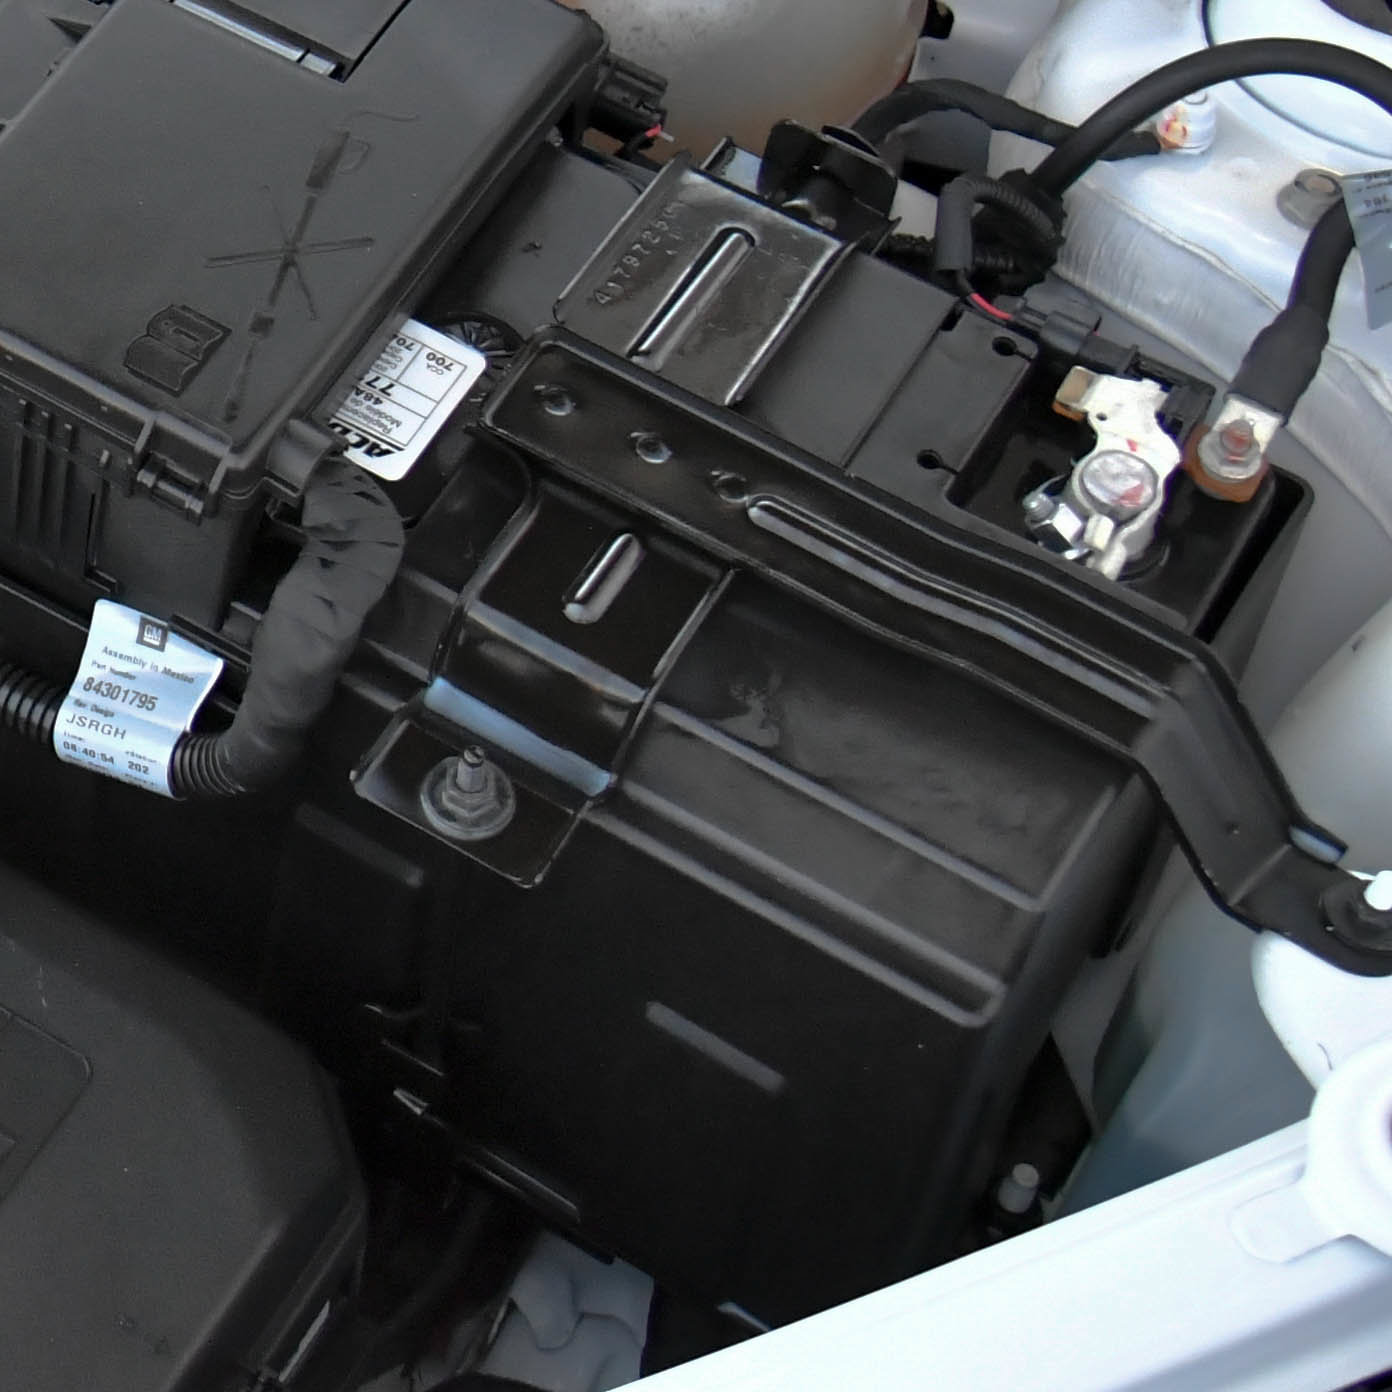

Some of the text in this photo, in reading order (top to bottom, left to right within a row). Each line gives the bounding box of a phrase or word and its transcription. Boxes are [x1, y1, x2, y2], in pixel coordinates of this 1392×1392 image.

[425, 351, 454, 371] 700
[425, 362, 445, 376] CCA
[360, 374, 392, 397] 77
[353, 386, 384, 406] 48A
[144, 623, 163, 642] GM
[102, 645, 196, 684] Assembly in Mexico
[82, 676, 159, 712] 84301795
[66, 714, 128, 741] JSRGH
[127, 759, 151, 776] 202
